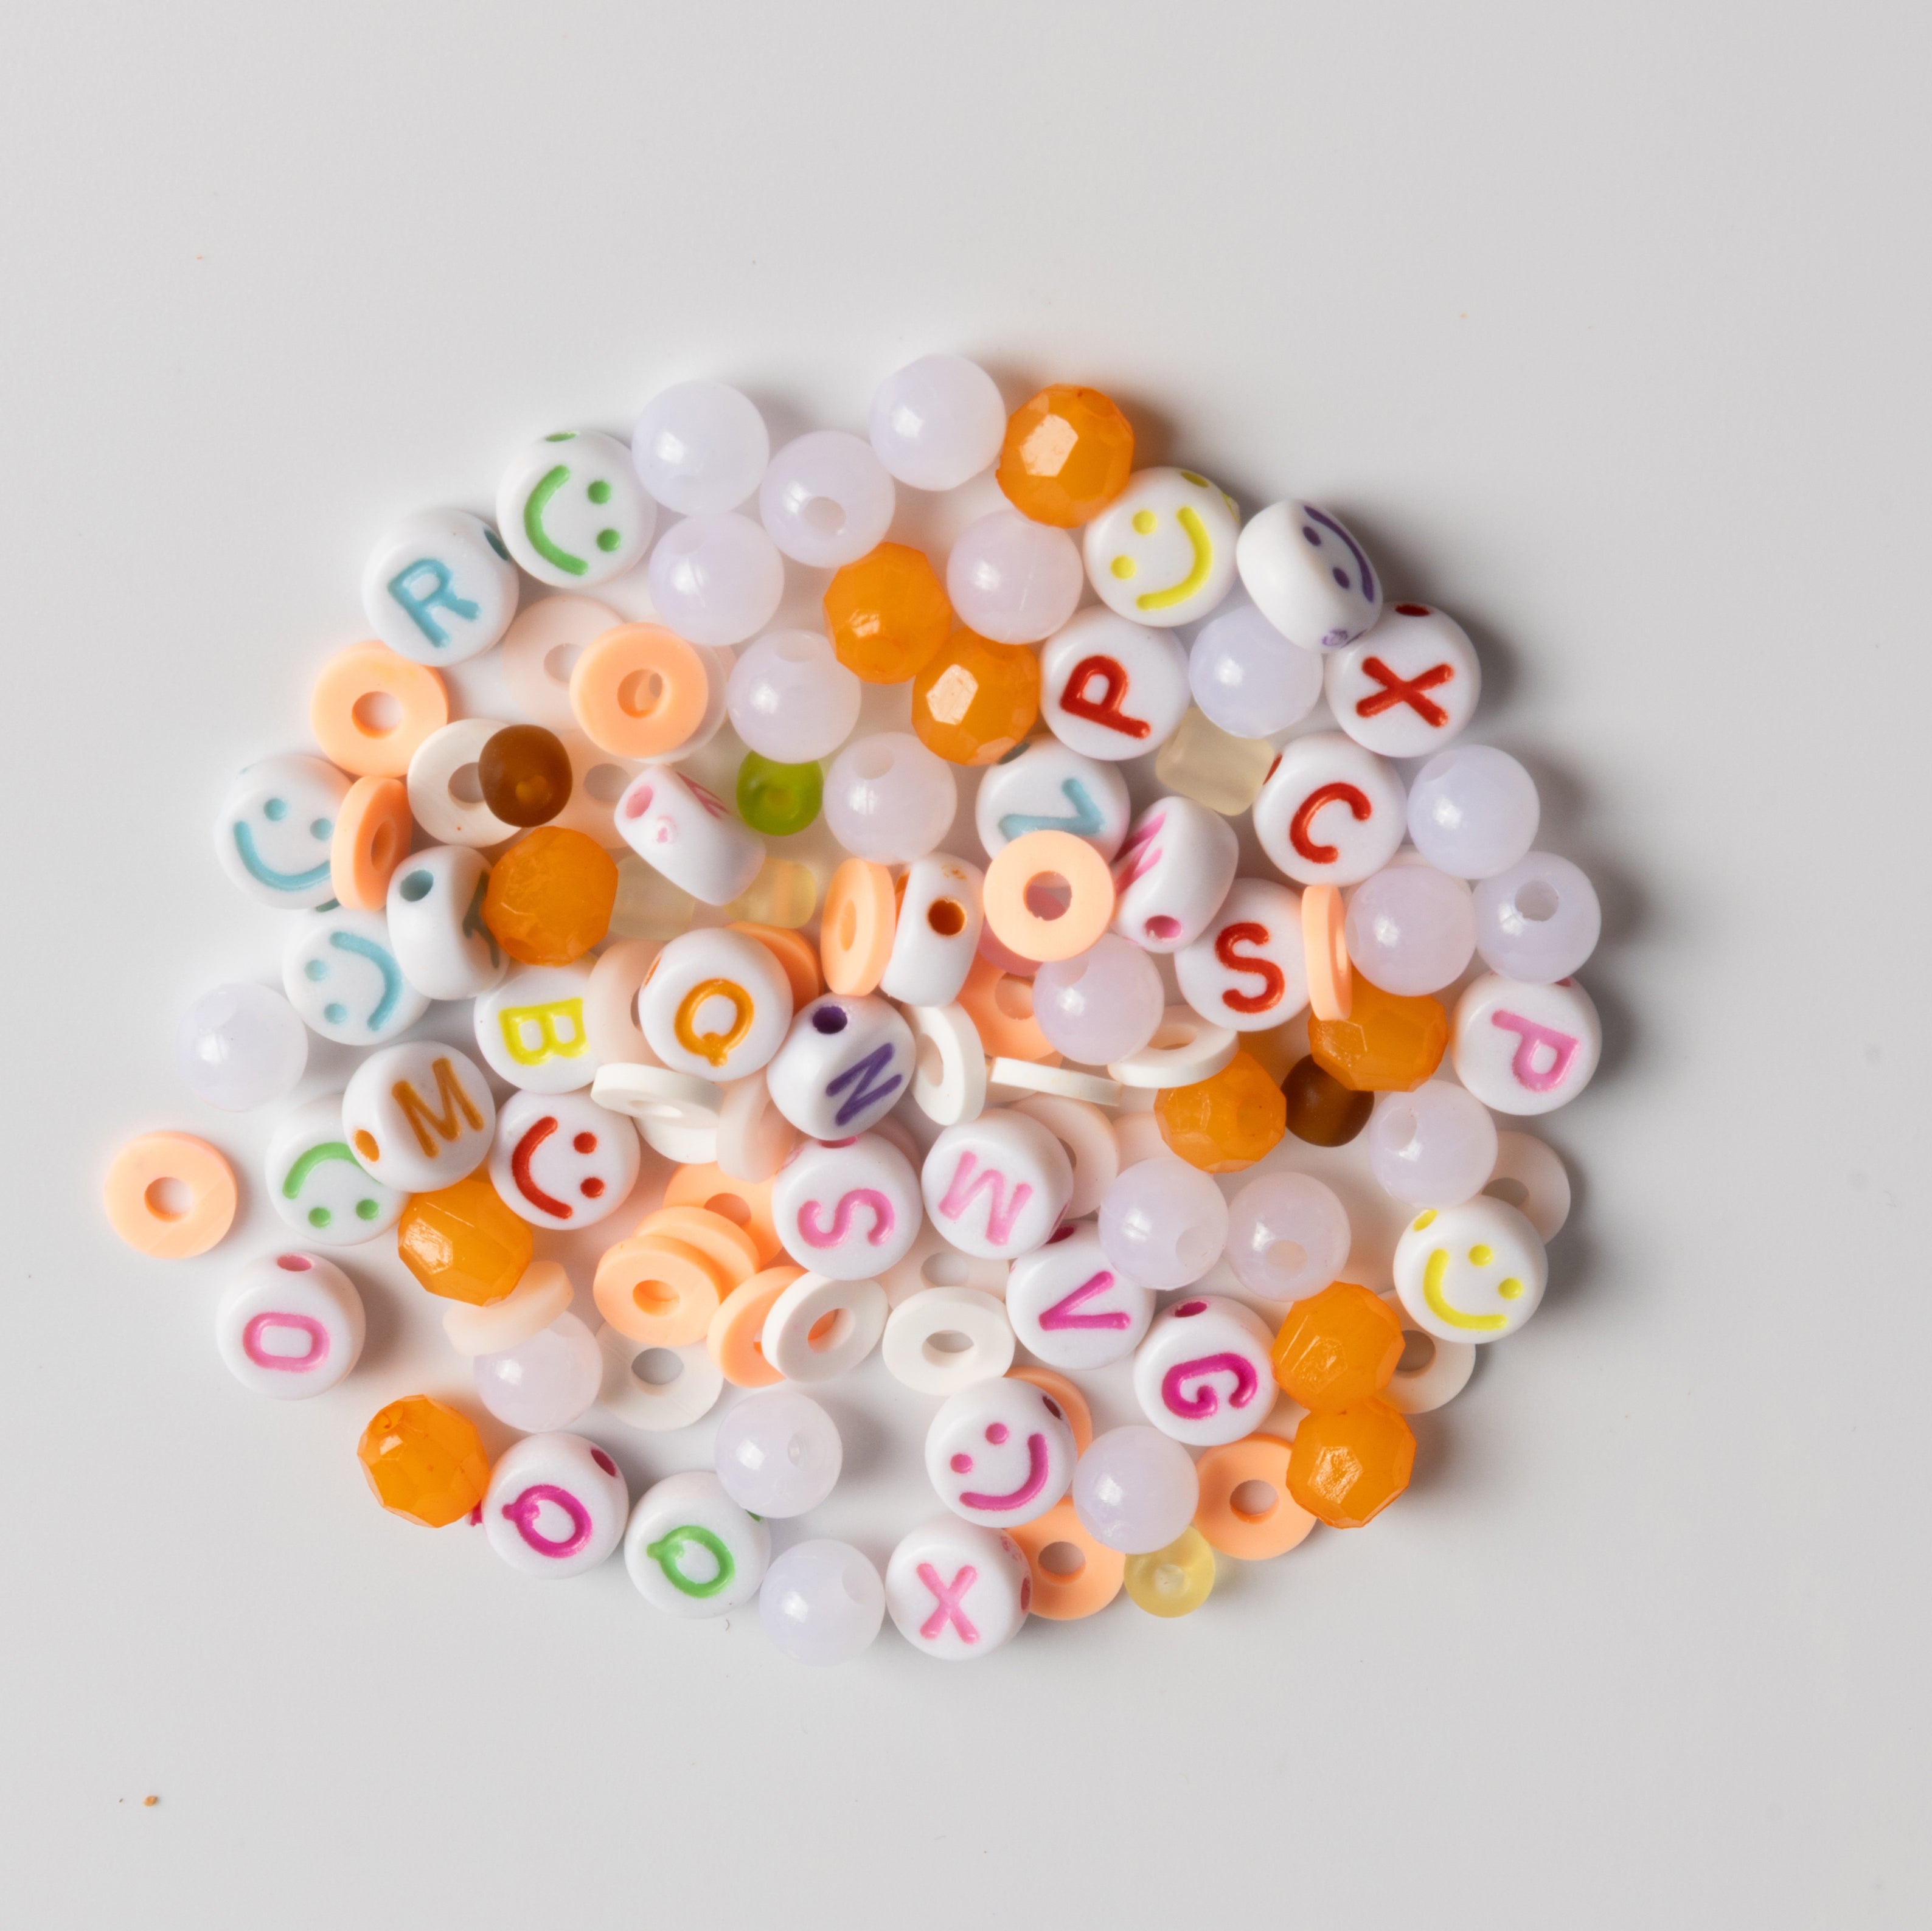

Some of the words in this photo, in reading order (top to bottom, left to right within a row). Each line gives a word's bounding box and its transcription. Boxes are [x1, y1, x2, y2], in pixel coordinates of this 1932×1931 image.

[388, 558, 482, 648] R
[1059, 654, 1151, 740] P
[1355, 656, 1454, 728] X
[1289, 782, 1372, 864] C
[1214, 921, 1285, 1014] S
[498, 997, 588, 1066] B
[673, 978, 754, 1067] Q
[1490, 1009, 1580, 1093] P
[392, 1057, 485, 1159] M
[825, 1042, 902, 1127] N
[797, 1188, 894, 1249] S
[242, 1311, 330, 1373] O
[1038, 1271, 1131, 1331] V
[1161, 1352, 1259, 1421] G
[500, 1484, 592, 1559] Q
[645, 1525, 735, 1599] Q
[916, 1561, 981, 1645] X
